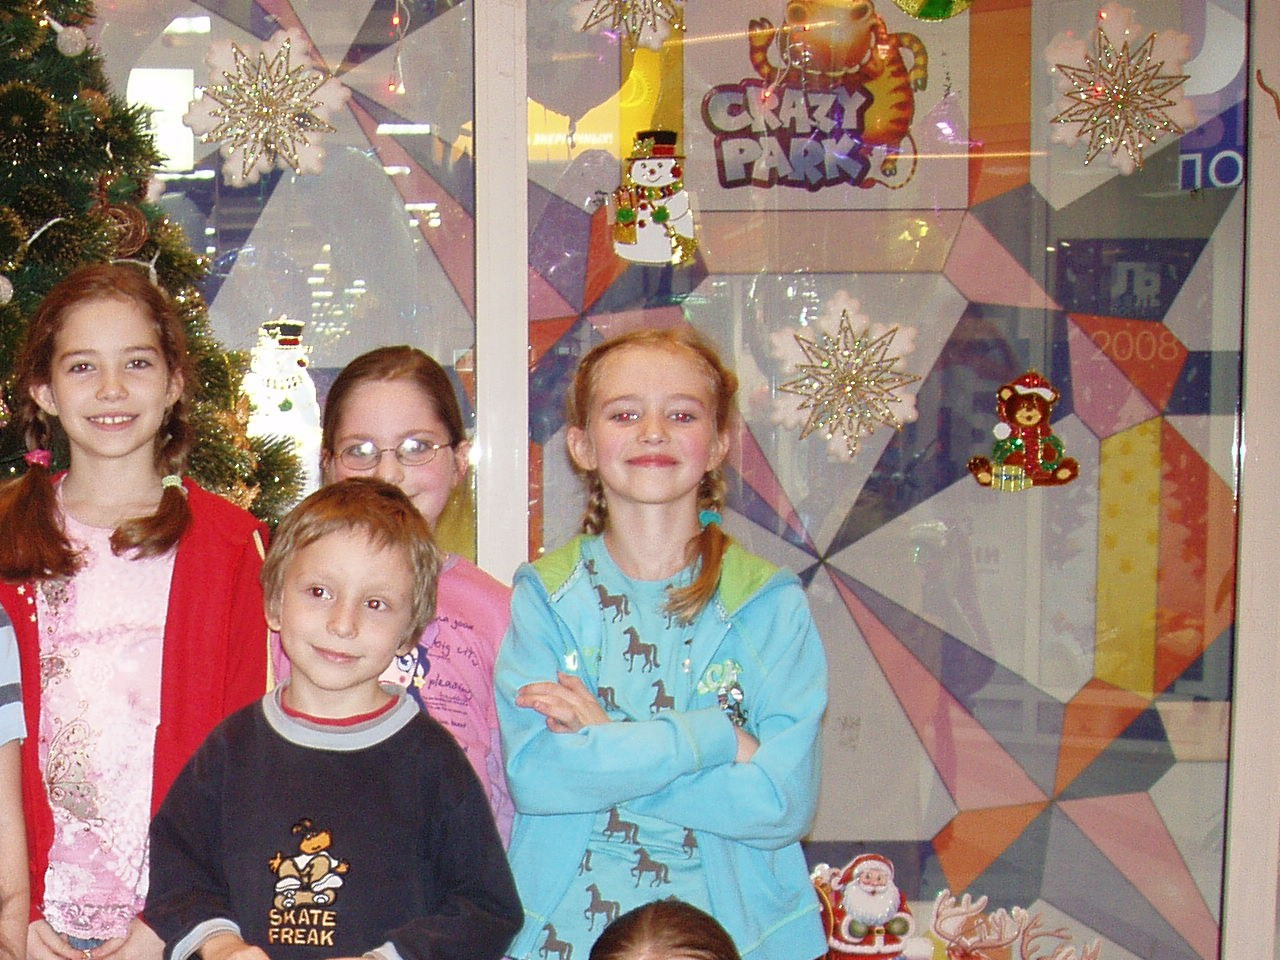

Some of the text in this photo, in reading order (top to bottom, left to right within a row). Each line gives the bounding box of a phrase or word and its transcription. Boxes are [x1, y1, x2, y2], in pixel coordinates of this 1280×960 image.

[704, 82, 870, 134] CRAZY
[717, 132, 867, 189] PARK
[1089, 329, 1180, 362] 2008
[269, 908, 337, 927] SKATE
[268, 927, 336, 946] FREAK
